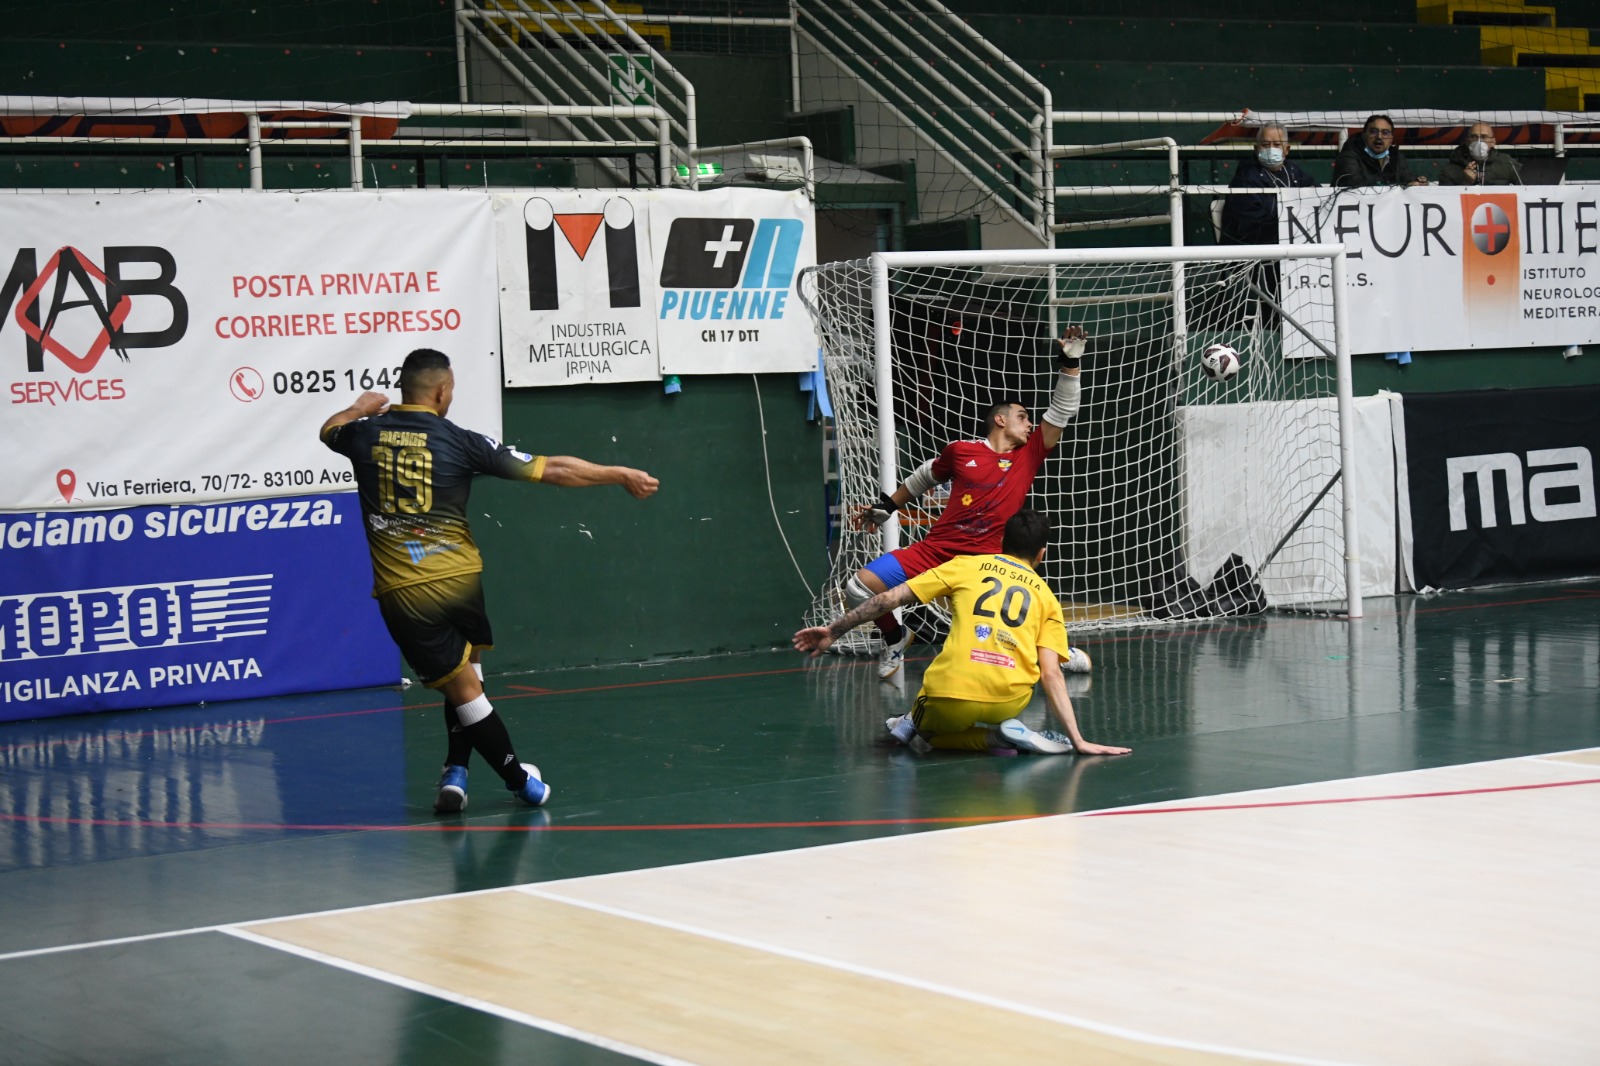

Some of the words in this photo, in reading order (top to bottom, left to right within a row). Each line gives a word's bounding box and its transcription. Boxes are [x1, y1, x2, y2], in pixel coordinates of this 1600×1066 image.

[232, 275, 314, 298] POSTA
[321, 272, 420, 295] PRIVATA
[426, 271, 440, 292] E
[1523, 267, 1586, 280] ISTITUTO
[659, 290, 788, 320] PIUENNE
[1523, 305, 1600, 319] MEDITERR
[215, 314, 337, 339] CORRIERE
[344, 308, 461, 334] ESPRESSO
[551, 322, 627, 341] INDUSTRIA
[701, 329, 717, 342] CH
[720, 329, 734, 342] 17
[738, 329, 760, 342] DTT
[529, 340, 651, 363] METALLURGICA
[273, 370, 337, 395] 0825
[344, 367, 403, 391] 1642
[566, 360, 612, 378] IRPINA
[10, 377, 126, 406] SERVICES
[87, 481, 119, 498] Via
[124, 477, 196, 497] Ferriera,
[263, 470, 314, 488] 83100
[371, 445, 433, 514] 19
[1446, 446, 1597, 532] ma
[144, 499, 342, 539] sicurezza.
[979, 562, 1007, 576] JOAO
[1009, 571, 1041, 591] SALLA
[972, 576, 1031, 628] 20
[149, 657, 263, 687] PRIVATA
